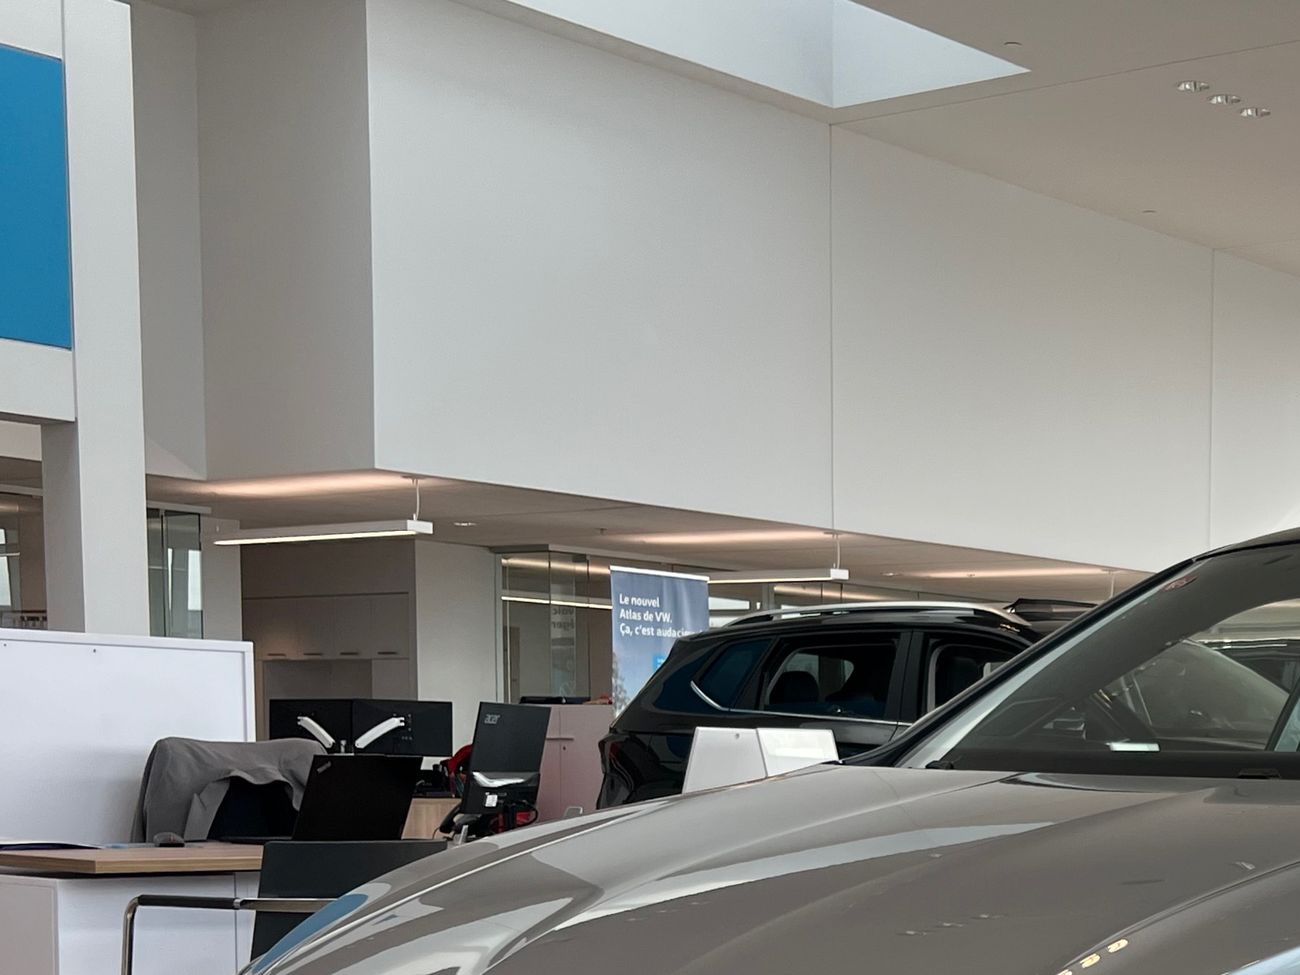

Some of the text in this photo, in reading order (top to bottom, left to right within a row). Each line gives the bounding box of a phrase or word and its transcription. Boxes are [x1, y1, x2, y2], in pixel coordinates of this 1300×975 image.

[619, 593, 660, 608] Le nouvel
[619, 608, 673, 624] Atlas de VW.
[619, 623, 633, 637] Ça,
[635, 624, 655, 636] c'est
[484, 714, 501, 725] acer
